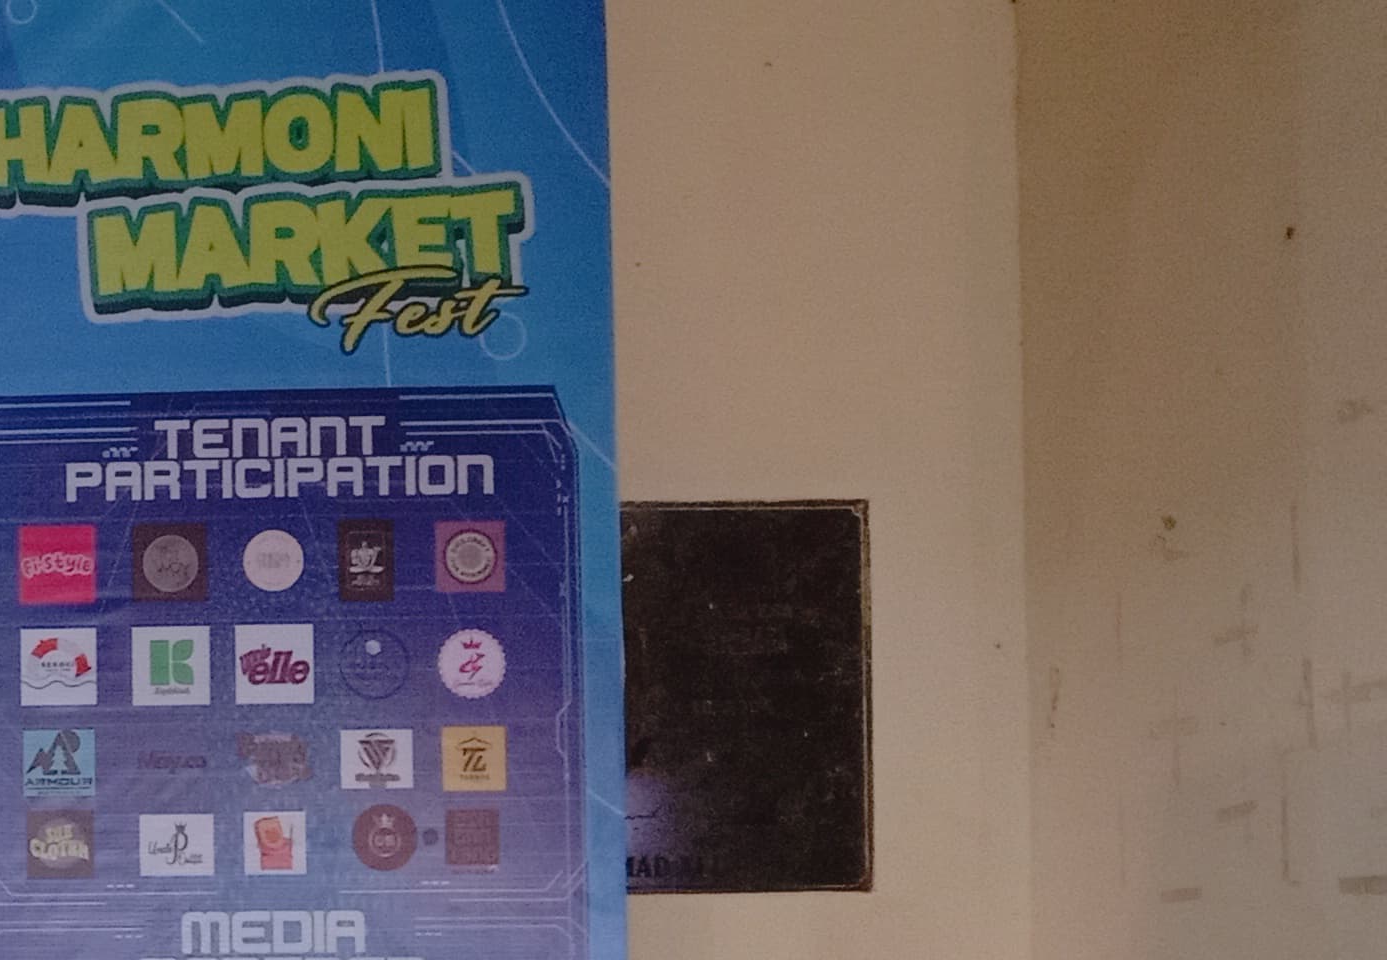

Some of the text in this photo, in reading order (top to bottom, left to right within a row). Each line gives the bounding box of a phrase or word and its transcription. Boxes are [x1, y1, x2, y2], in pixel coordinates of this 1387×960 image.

[90, 182, 526, 303] MARKET
[306, 264, 528, 355] Fest
[153, 416, 386, 459] TENANT
[65, 454, 495, 502] PARTICIPATION
[181, 910, 366, 954] MEDIA
